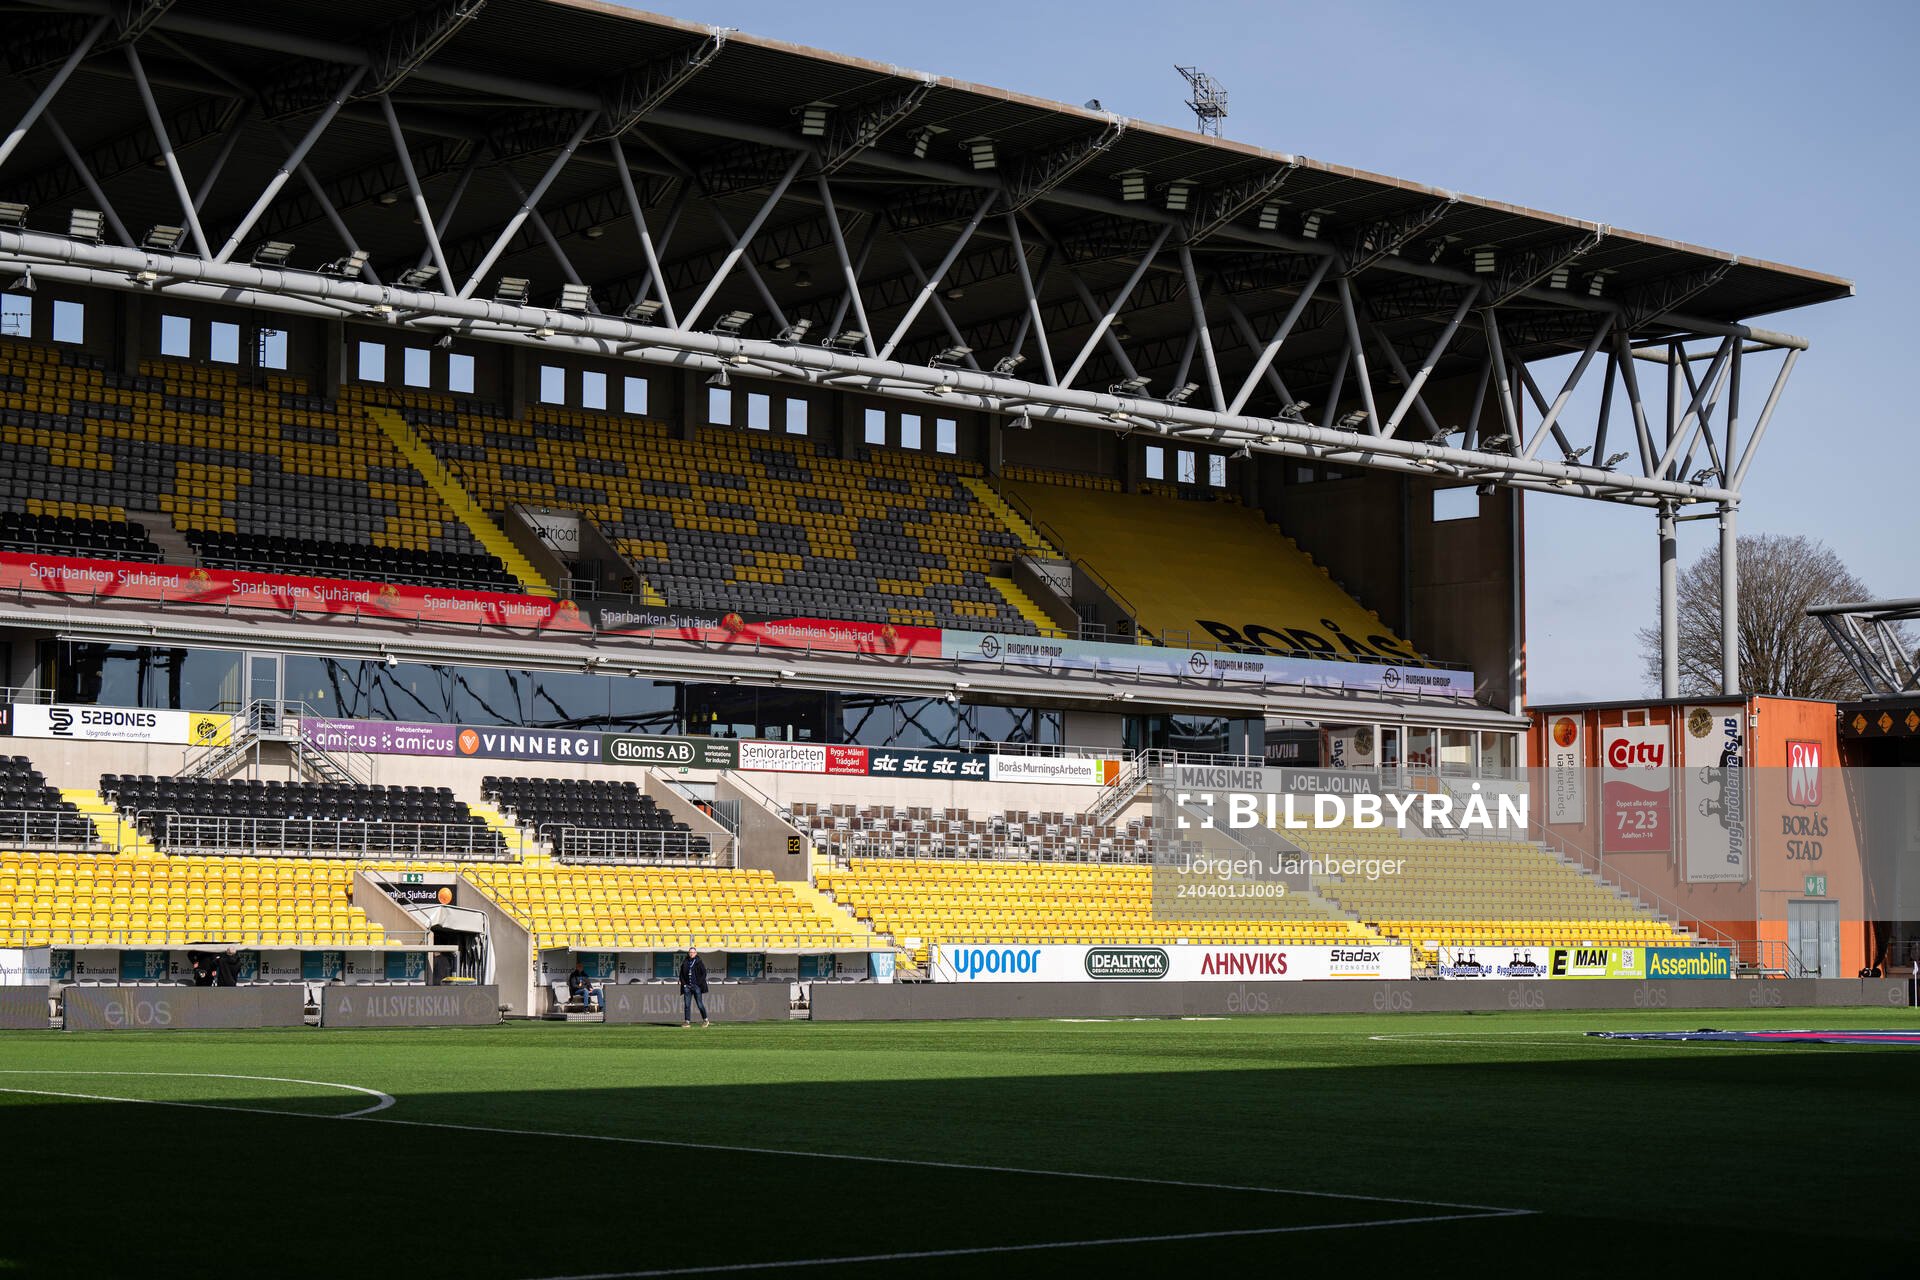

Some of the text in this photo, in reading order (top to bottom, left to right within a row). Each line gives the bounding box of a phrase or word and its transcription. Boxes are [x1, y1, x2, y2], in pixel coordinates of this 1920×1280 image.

[29, 562, 180, 588] Sparbanken Sjuhärad
[232, 578, 370, 603] Sparbanken Sjuhärad
[423, 594, 551, 617] Sparbanken Sjuhärad
[600, 608, 718, 630] Sparbanken Sjuhärad
[764, 621, 874, 642] Sparbanken Sjuhärad
[1007, 643, 1039, 656] RUDHOLM
[1040, 645, 1063, 657] GROUP
[1214, 659, 1243, 671] RUDHOLM
[1243, 662, 1264, 673] GROUP
[1405, 674, 1432, 686] RUDHOLM
[1432, 676, 1451, 687] GROUP
[81, 710, 157, 728] 52BONES
[86, 730, 111, 738] Upgrade
[316, 731, 377, 747] amicus
[395, 737, 454, 751] amicus
[482, 734, 599, 757] VINNERGI
[617, 742, 689, 760] Bloms AB
[742, 743, 824, 761] Seniorarbeten
[1608, 738, 1665, 771] City
[873, 755, 985, 776] stc stc stc stc
[998, 759, 1092, 777] Borås MurningsArbeten
[1182, 767, 1263, 790] MAKSIMER
[1556, 753, 1564, 816] Sparbanken
[1566, 753, 1575, 801] Sjuhärad
[1616, 810, 1658, 830] 7-23
[1781, 811, 1829, 837] BORÅS
[1786, 841, 1823, 861] STAD
[407, 890, 437, 900] Sjuhärad
[954, 949, 1041, 980] uponor
[1092, 954, 1162, 968] IDEALTRYCK
[1330, 949, 1380, 962] Stadax
[1650, 951, 1727, 976] Assemblin
[366, 994, 460, 1017] ALLSVENSKAN
[1227, 984, 1269, 1012] ellos
[1373, 984, 1412, 1010] ellos
[1508, 983, 1544, 1008] ellos
[104, 990, 172, 1025] ellos
